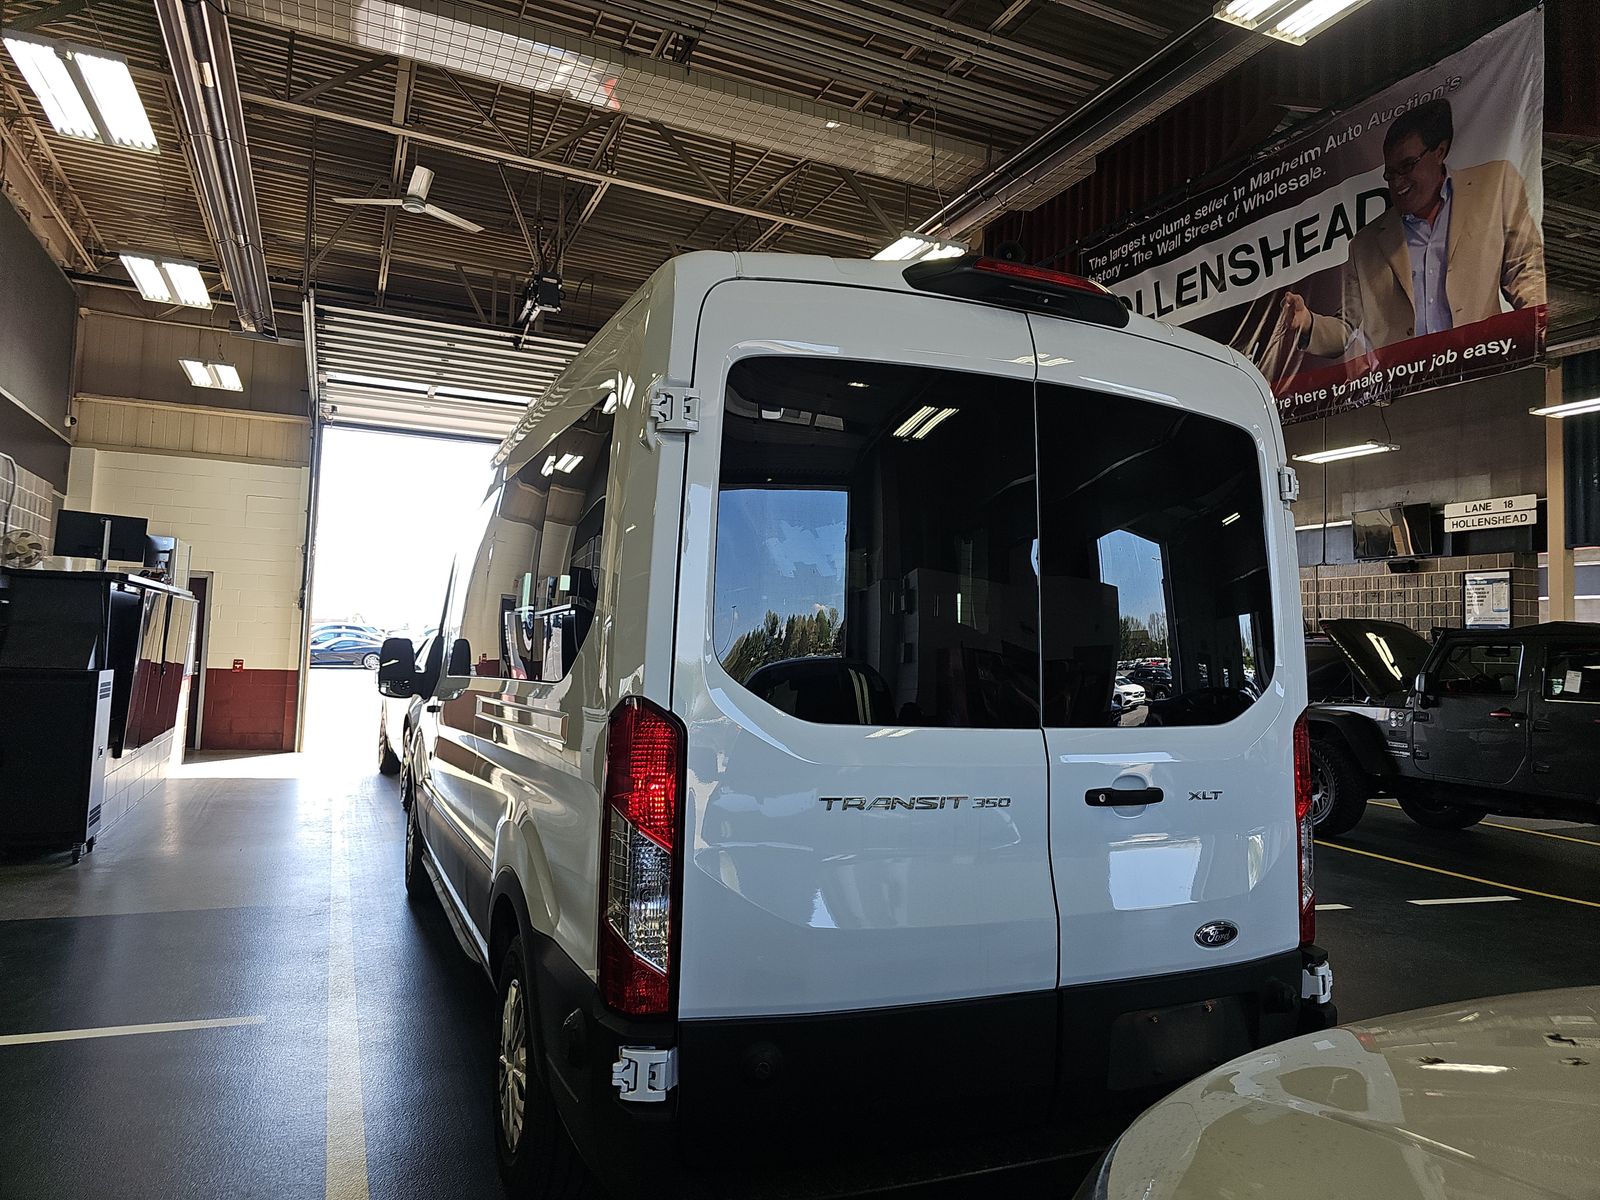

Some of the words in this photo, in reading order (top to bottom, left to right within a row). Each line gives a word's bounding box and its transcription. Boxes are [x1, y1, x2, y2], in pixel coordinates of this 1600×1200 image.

[1088, 255, 1108, 271] The
[1110, 234, 1147, 261] largest
[1150, 214, 1191, 243] volume
[1194, 194, 1230, 220] seller
[1233, 186, 1246, 202] in
[1250, 145, 1322, 192] Manheim
[1325, 123, 1362, 154] Auto
[1367, 74, 1462, 130] Auction's
[1132, 249, 1153, 267] The
[1156, 234, 1181, 256] Wall
[1184, 214, 1223, 243] Street
[1227, 205, 1240, 223] of
[1243, 167, 1327, 214] Wholesale.
[1295, 389, 1328, 406] here
[1331, 383, 1346, 397] to
[1350, 371, 1383, 392] make
[1387, 358, 1426, 382] your
[1429, 349, 1458, 372] job
[1463, 337, 1518, 361] easy.
[1465, 502, 1493, 513] LANE
[1503, 500, 1514, 509] 18
[1451, 513, 1528, 529] HOLLENSHEAD
[818, 796, 969, 811] TRANSIT
[972, 797, 1012, 809] 350
[1188, 790, 1223, 801] XLT
